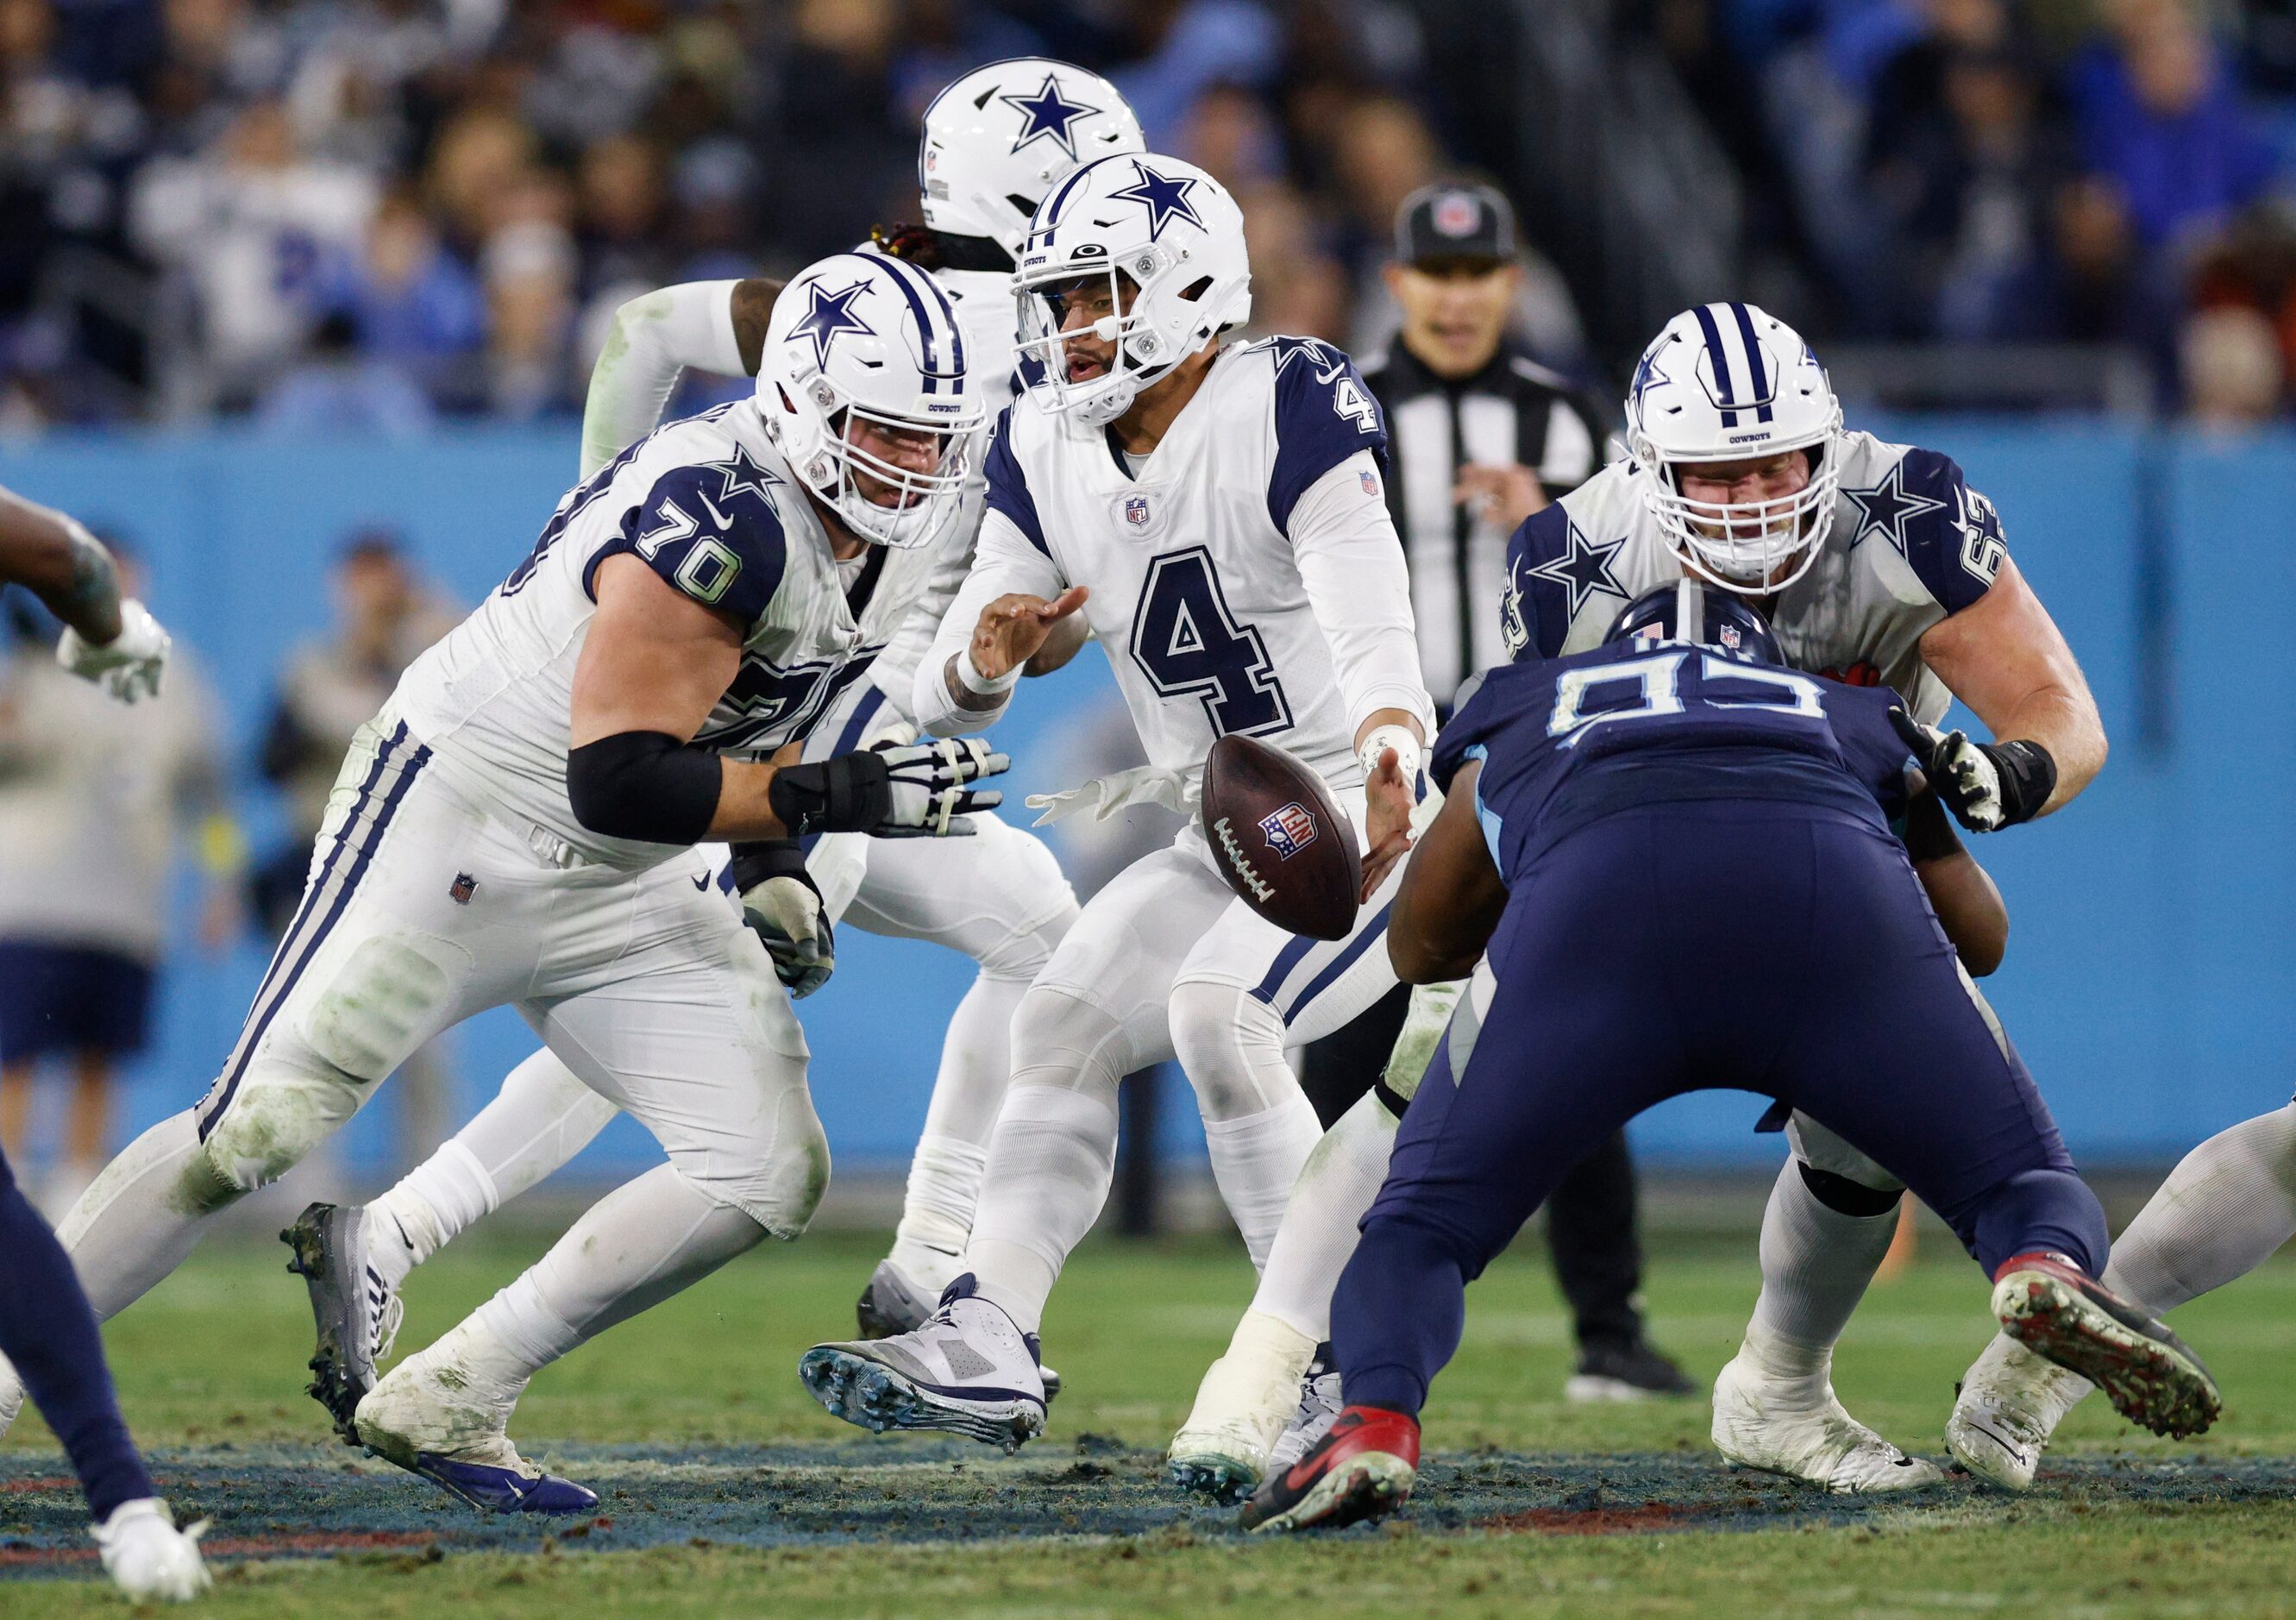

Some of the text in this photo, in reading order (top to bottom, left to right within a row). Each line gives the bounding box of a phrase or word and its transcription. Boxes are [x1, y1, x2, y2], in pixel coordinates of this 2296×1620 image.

[928, 404, 962, 412] COWBOYS
[1333, 377, 1379, 434] 4
[1729, 432, 1771, 443] COWBOYS
[1364, 480, 1377, 495] NFL
[1129, 508, 1146, 522] NFL
[635, 496, 743, 604] 70
[1960, 485, 2007, 589] 63
[1129, 544, 1295, 740] 4
[1723, 634, 1739, 645] NFL
[1281, 807, 1313, 845] NFL
